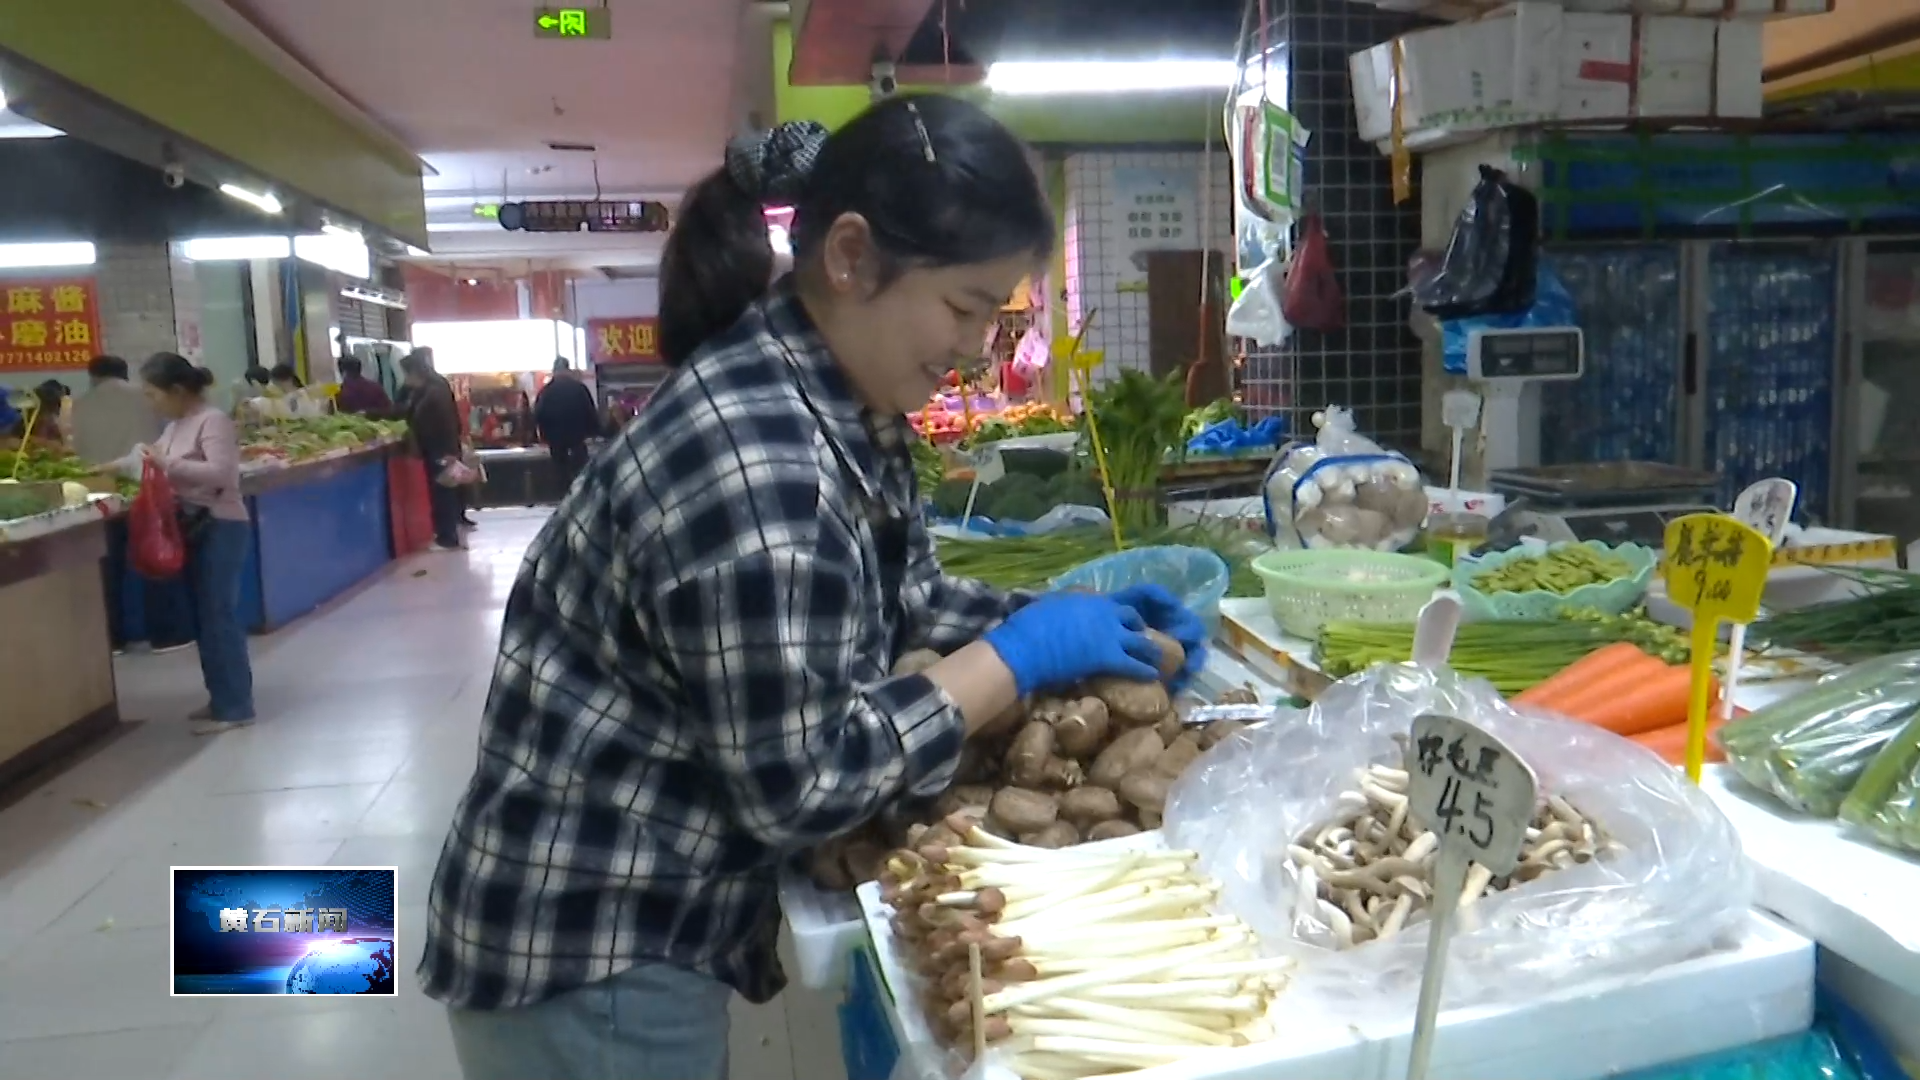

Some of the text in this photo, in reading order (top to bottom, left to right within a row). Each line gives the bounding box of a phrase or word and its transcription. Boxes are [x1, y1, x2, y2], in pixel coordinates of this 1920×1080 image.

[0, 319, 90, 347] 磨油
[598, 324, 655, 355] 欢迎
[1436, 776, 1494, 849] 4.5
